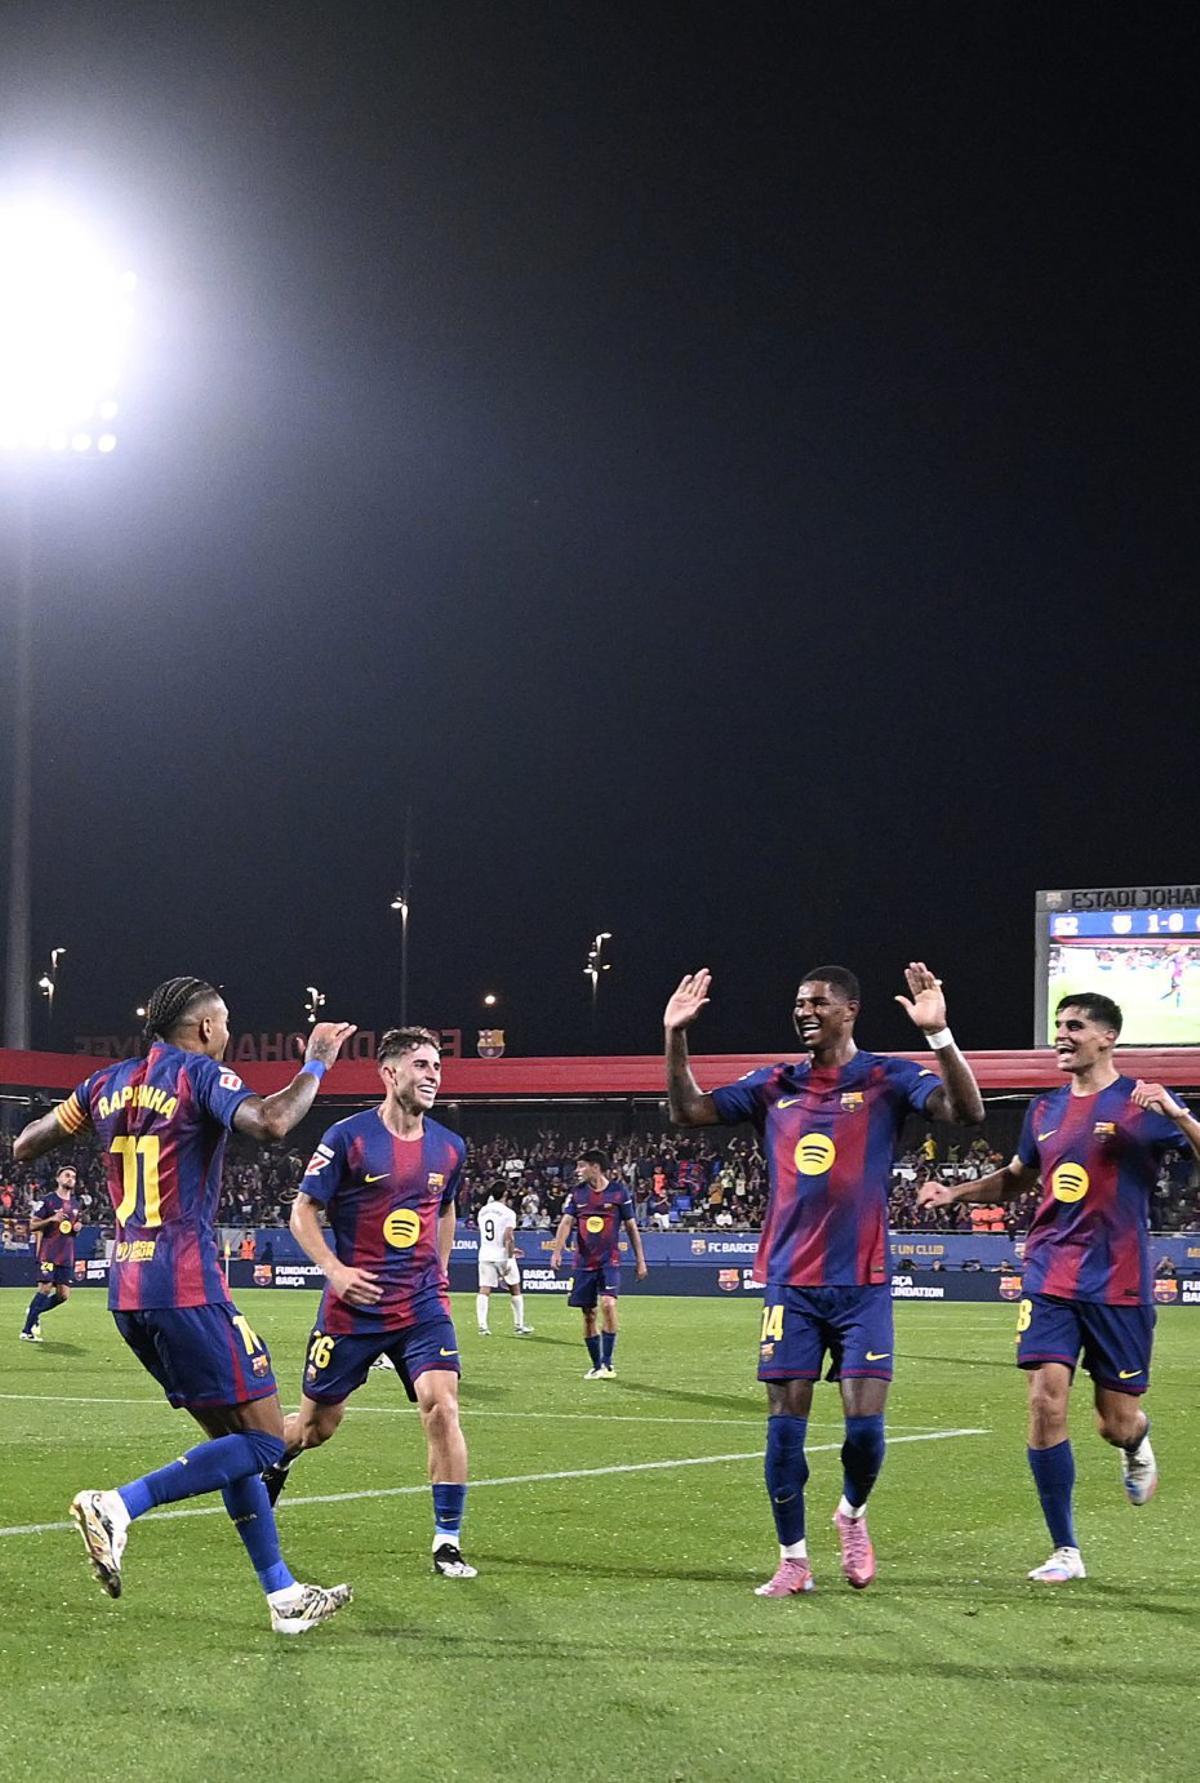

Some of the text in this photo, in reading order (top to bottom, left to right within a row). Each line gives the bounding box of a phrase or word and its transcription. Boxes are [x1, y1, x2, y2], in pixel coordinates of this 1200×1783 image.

[1071, 890, 1137, 908] ESTADI
[109, 1135, 162, 1228] 11
[484, 1219, 495, 1242] 9
[708, 1242, 759, 1253] FC BARCE
[916, 1245, 945, 1255] CLUB
[275, 1276, 305, 1287] BARÇA
[523, 1270, 556, 1281] BARÇA
[760, 1304, 784, 1342] 14
[309, 1330, 335, 1369] 16
